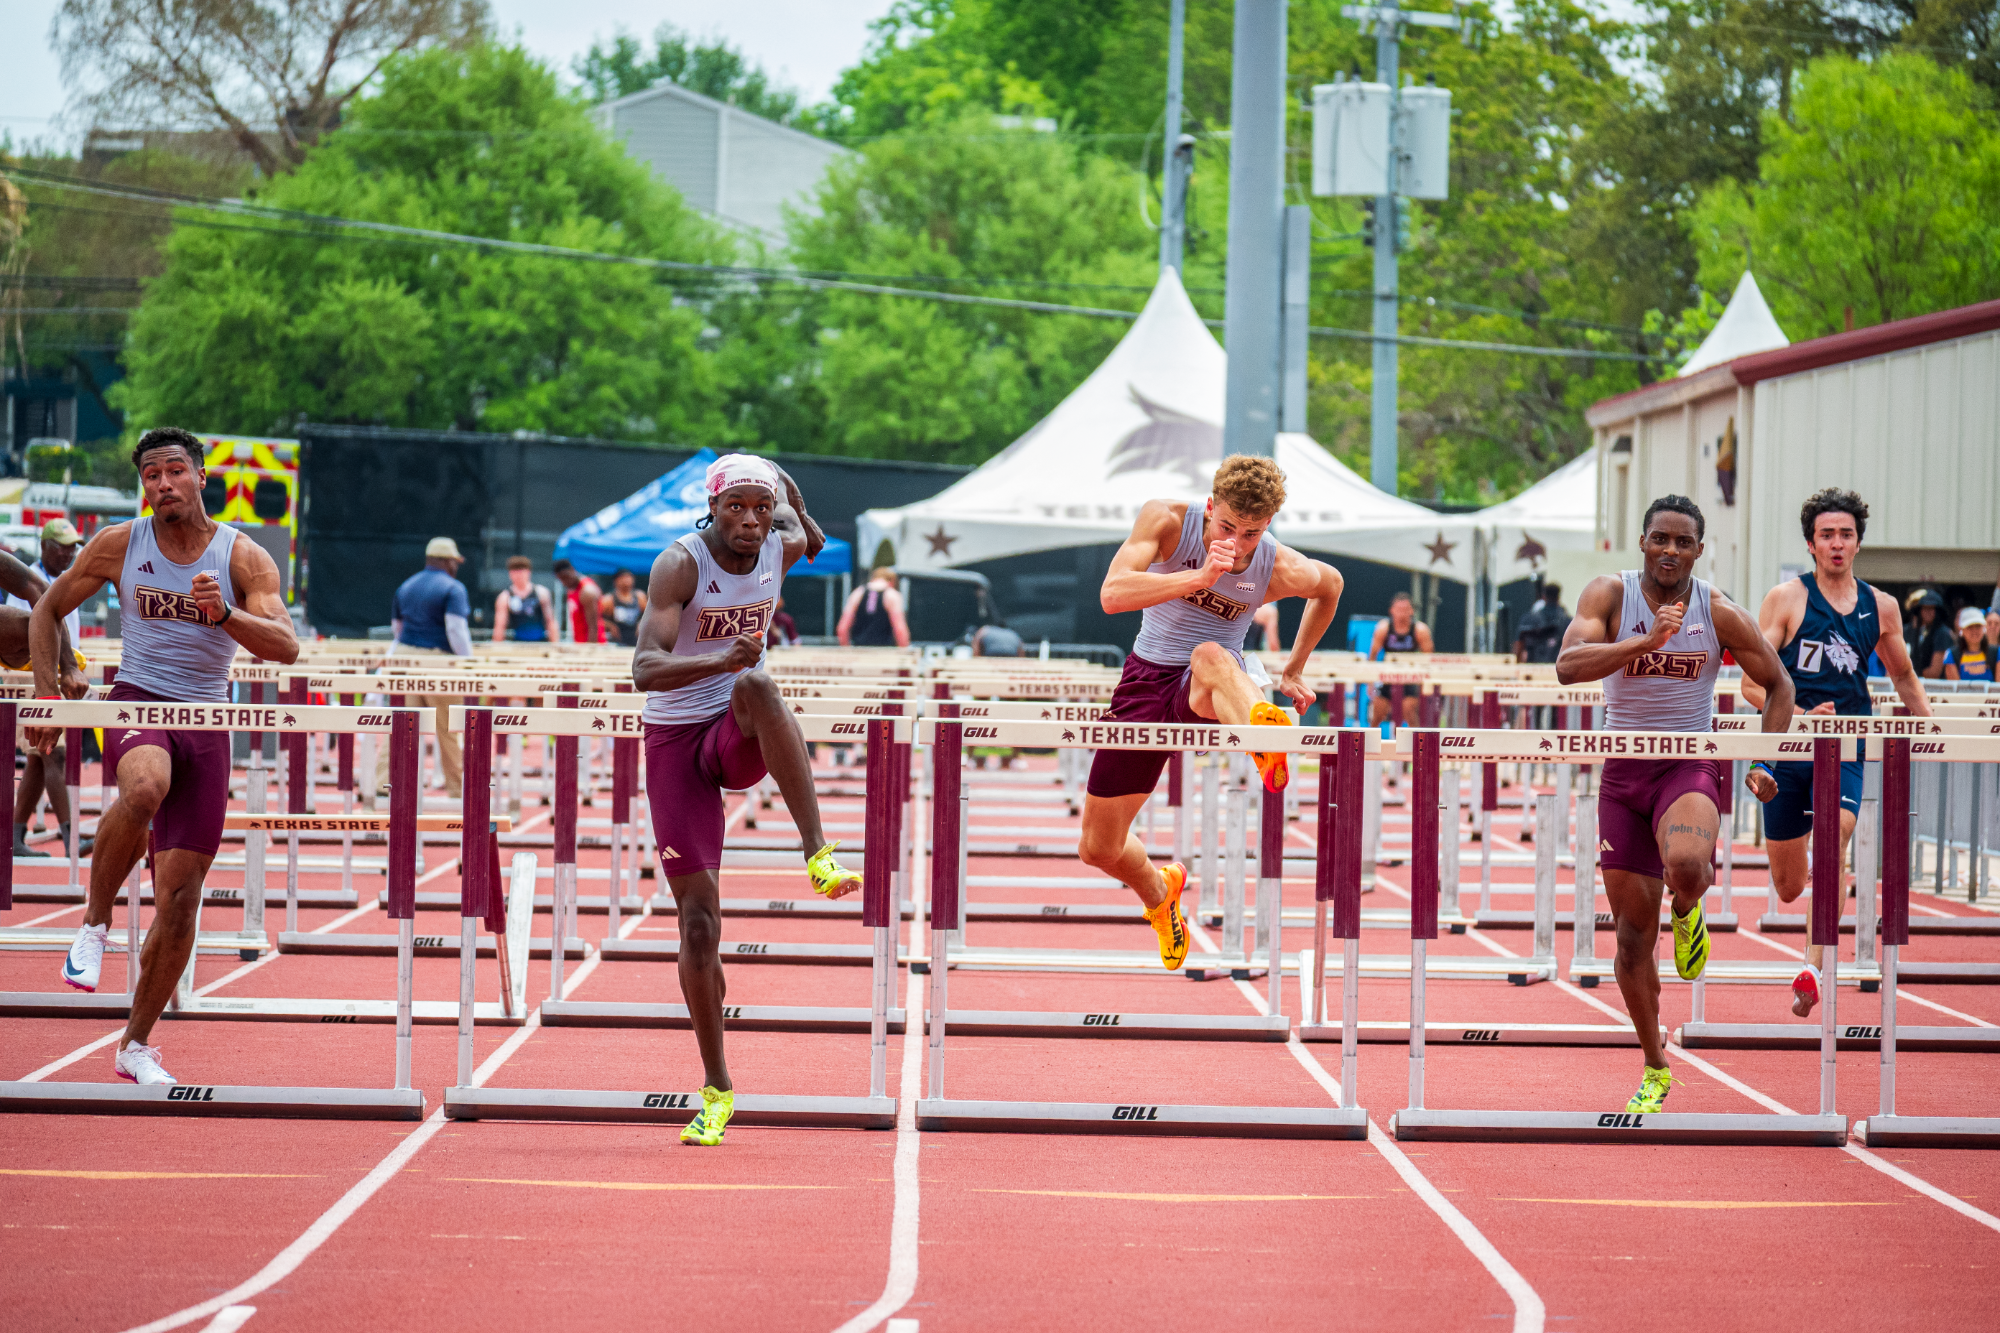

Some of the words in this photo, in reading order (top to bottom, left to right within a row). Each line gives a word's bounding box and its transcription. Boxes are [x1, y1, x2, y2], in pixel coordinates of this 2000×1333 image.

[727, 477, 752, 487] TEXAS
[1236, 581, 1256, 592] SBC
[1179, 587, 1251, 621] XST
[695, 597, 774, 642] TXST
[1802, 642, 1820, 668] 7
[1623, 650, 1709, 681] TXST
[233, 668, 271, 678] STATE
[310, 679, 333, 687] GILL
[388, 679, 436, 691] TEXAS
[440, 680, 484, 692] STATE
[1018, 684, 1060, 694] TEXAS
[1063, 685, 1101, 694] STATE
[781, 688, 809, 697] ATE
[863, 691, 886, 699] GILL
[1567, 692, 1604, 702] TEXA
[580, 699, 608, 708] GILL
[18, 707, 54, 719] GILL
[853, 705, 881, 715] GILL
[961, 707, 989, 716] GILL
[1055, 706, 1107, 721] TEXA
[135, 706, 206, 726] TEXAS
[212, 708, 276, 727] STATE
[357, 714, 393, 726] GILL
[494, 714, 529, 726] GILL
[609, 714, 645, 732] TEX
[831, 722, 866, 734] GILL
[1718, 720, 1747, 730] GILL
[1811, 719, 1869, 734] TEXAS
[1873, 720, 1926, 735] STATE
[963, 727, 999, 738] GILL
[1079, 726, 1150, 745] TEXAS
[1156, 728, 1220, 747] STATE
[1300, 734, 1336, 746] GILL
[1440, 736, 1476, 748] GILL
[1556, 735, 1628, 753] TEXAS
[1633, 736, 1698, 754] STATE
[1777, 741, 1813, 753] GILL
[1910, 742, 1946, 754] GILL
[263, 819, 322, 830] TEXAS
[327, 820, 380, 830] STATE
[211, 889, 237, 899] GILL
[413, 937, 444, 947] GILL
[736, 943, 768, 953] GILL
[723, 1007, 742, 1019] LL
[320, 1015, 357, 1024] GILL
[1083, 1013, 1120, 1026] GILL
[1462, 1030, 1500, 1041] GILL
[1844, 1026, 1882, 1039] GILL
[167, 1086, 214, 1101] GILL
[642, 1093, 689, 1109] GILL
[1112, 1105, 1158, 1121] GILL
[1597, 1113, 1644, 1128] GILL
